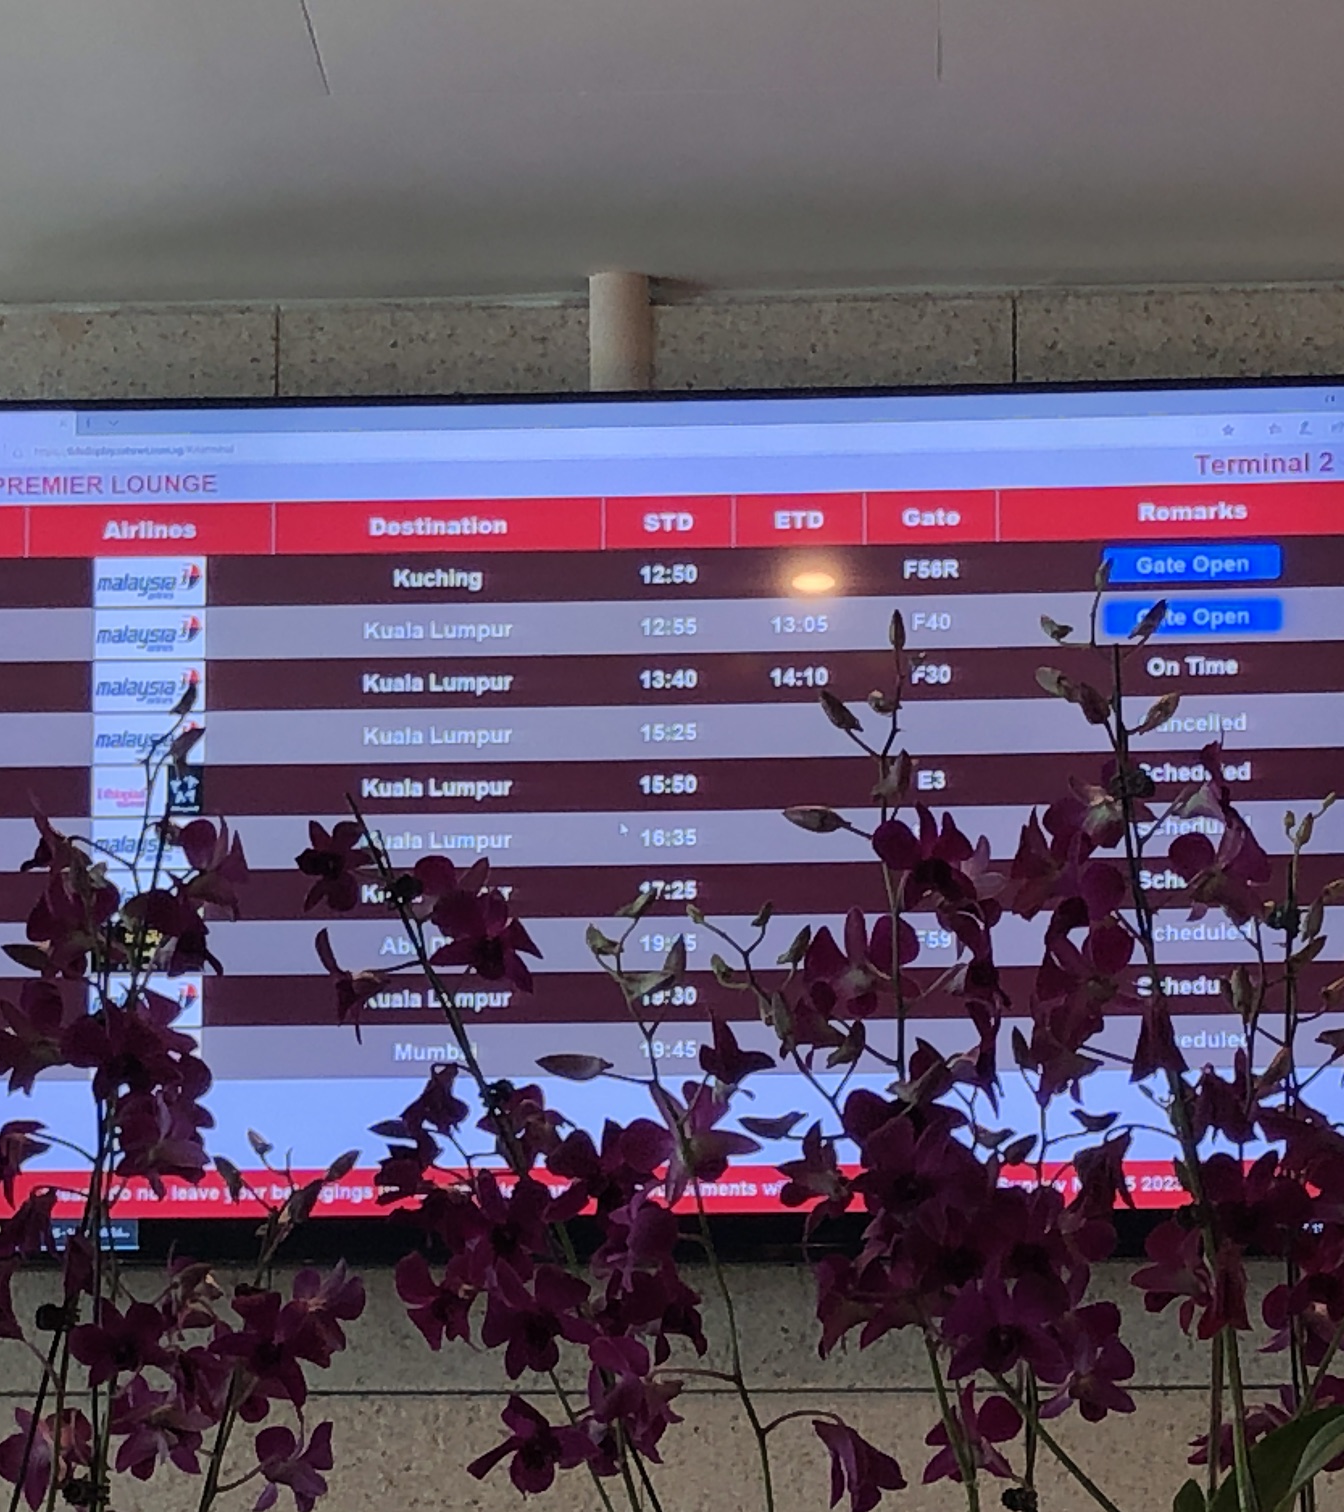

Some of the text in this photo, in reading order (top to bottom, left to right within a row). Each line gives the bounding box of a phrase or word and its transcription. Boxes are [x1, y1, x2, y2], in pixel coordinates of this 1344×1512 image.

[1194, 452, 1336, 475] Terminal 2
[111, 474, 218, 494] LOUNGE
[643, 512, 695, 532] STD
[773, 511, 825, 530] ETD
[902, 507, 962, 528] Gate
[1137, 501, 1248, 522] Remarks
[102, 521, 197, 540] Airlines
[368, 516, 508, 537] Destination
[639, 564, 698, 585] 12:50
[1136, 555, 1251, 577] Gate Open
[392, 568, 484, 592] Kuching
[640, 617, 698, 636] 12:55
[770, 615, 829, 634] 13:05
[911, 611, 952, 632] F40
[1193, 607, 1251, 630] Open
[362, 619, 514, 642] Kuala Lumpur
[910, 664, 952, 685] F30
[1146, 655, 1239, 677] On Time
[362, 672, 515, 696] Kuala Lumpur
[639, 669, 698, 690] 13:40
[769, 666, 829, 688] 14:10
[362, 725, 513, 748] Kuala Lumpur
[640, 723, 698, 742] 15:25
[361, 777, 514, 801] Kuala Lumpur
[639, 774, 698, 795] 15:50
[916, 769, 947, 791] E3
[428, 831, 514, 854] Lumpur
[640, 828, 698, 847] 16:35
[1154, 922, 1253, 942] cheduled
[639, 1039, 698, 1058] 19:45
[171, 1184, 220, 1201] leave
